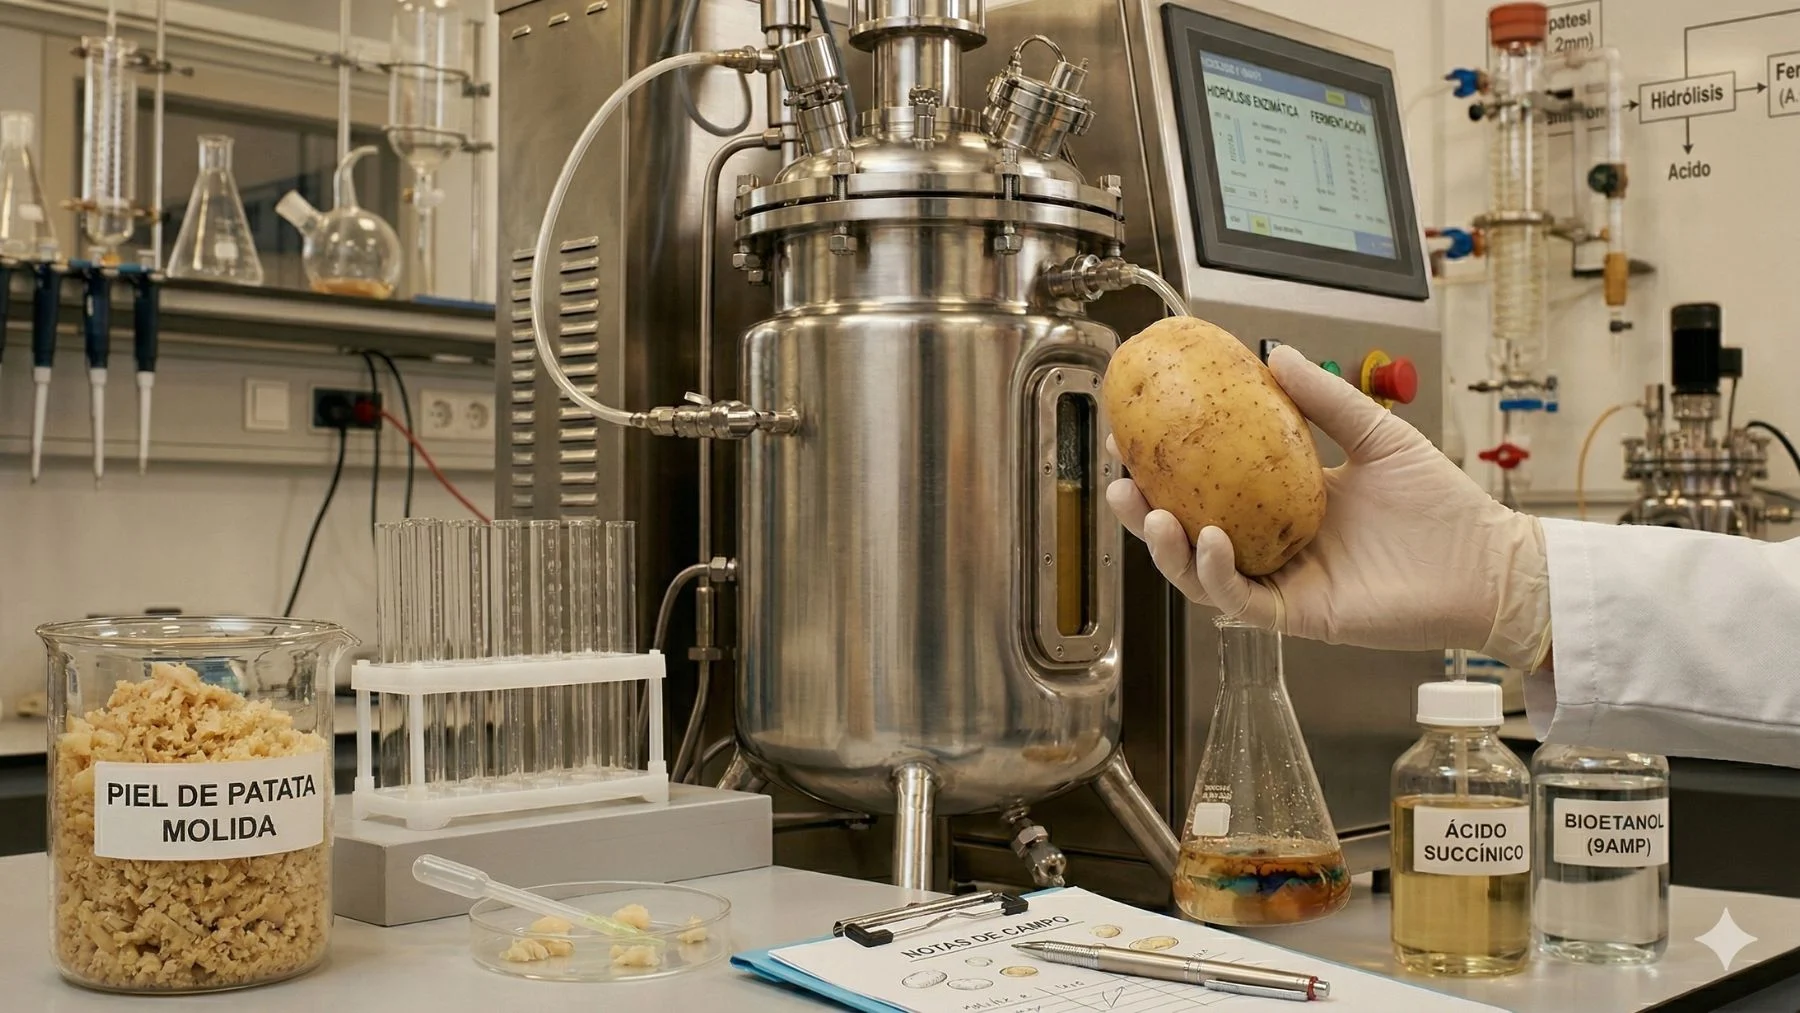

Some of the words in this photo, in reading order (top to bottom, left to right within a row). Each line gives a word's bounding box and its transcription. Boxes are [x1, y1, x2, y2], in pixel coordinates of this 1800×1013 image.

[1651, 83, 1724, 110] Hidrólisis
[1668, 160, 1711, 181] Acido
[107, 782, 169, 808] PIEL
[178, 784, 218, 807] DE
[228, 774, 316, 806] PATATA
[162, 814, 277, 843] MOLIDA
[1445, 819, 1507, 839] ÁCIDO
[1565, 813, 1664, 830] BIOETANOL
[1424, 843, 1524, 862] SUCCÍNICO
[1587, 838, 1651, 857] (9AMP)
[901, 938, 972, 959] NOTAS
[971, 931, 1002, 943] DE
[1002, 915, 1070, 936] CAMPO
